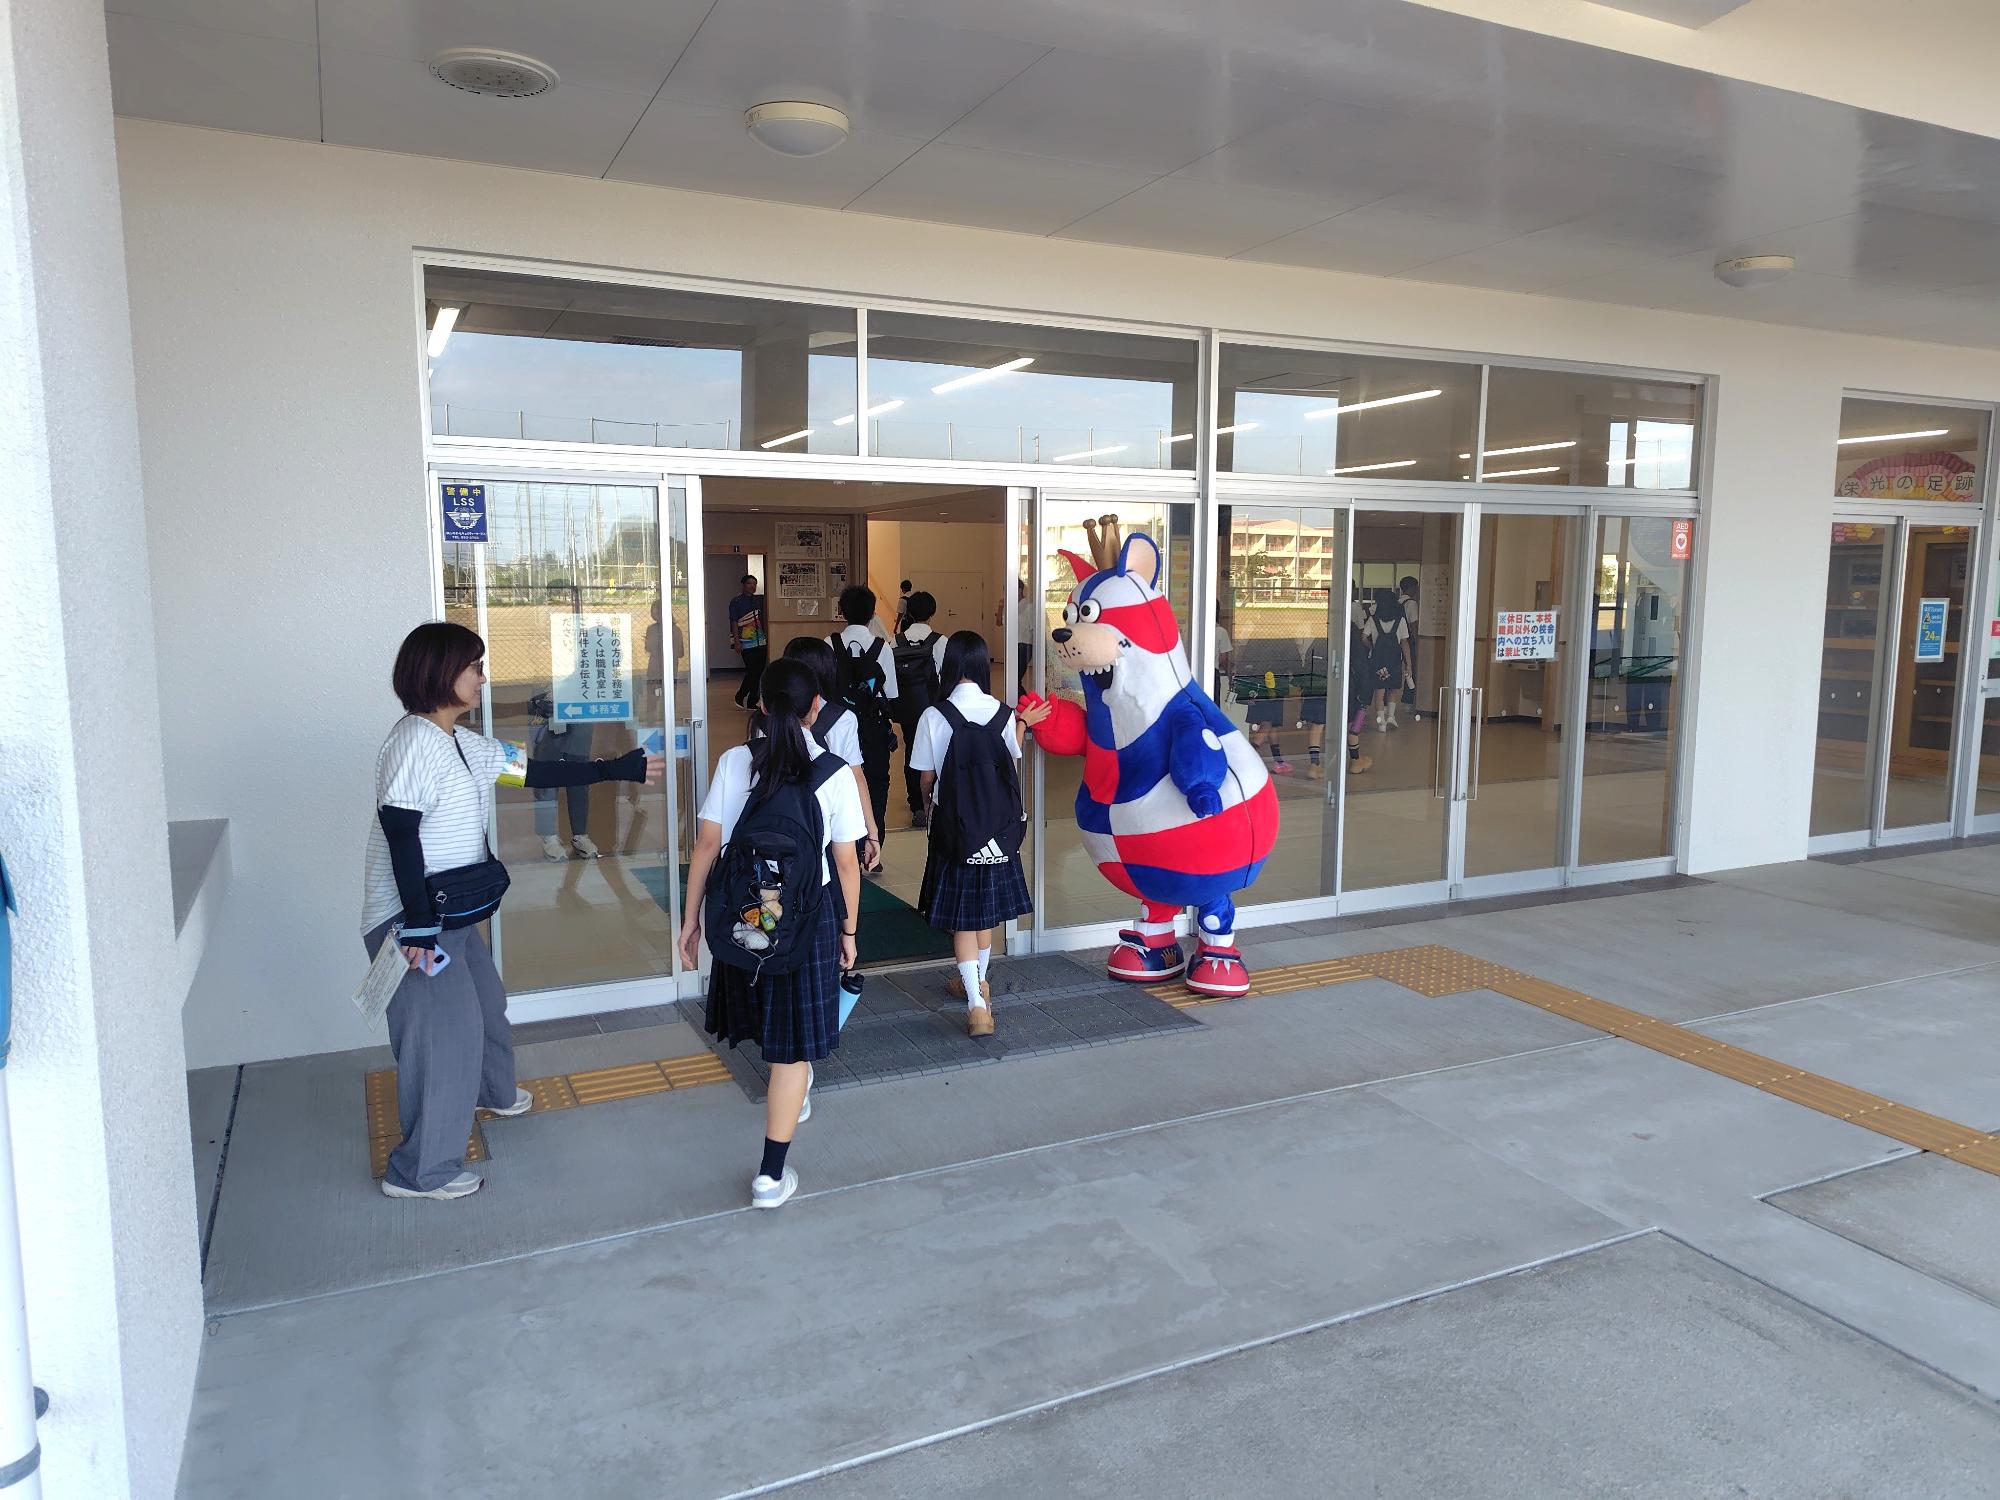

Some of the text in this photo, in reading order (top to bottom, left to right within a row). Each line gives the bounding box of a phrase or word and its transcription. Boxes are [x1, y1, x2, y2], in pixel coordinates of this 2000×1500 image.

[446, 486, 481, 496] 警備中
[1843, 475, 1974, 497] 栄光の足跡
[453, 497, 475, 506] LSS
[1497, 635, 1554, 647] 内への立ち入り
[589, 704, 621, 715] 事務室
[966, 855, 1009, 865] adidas
